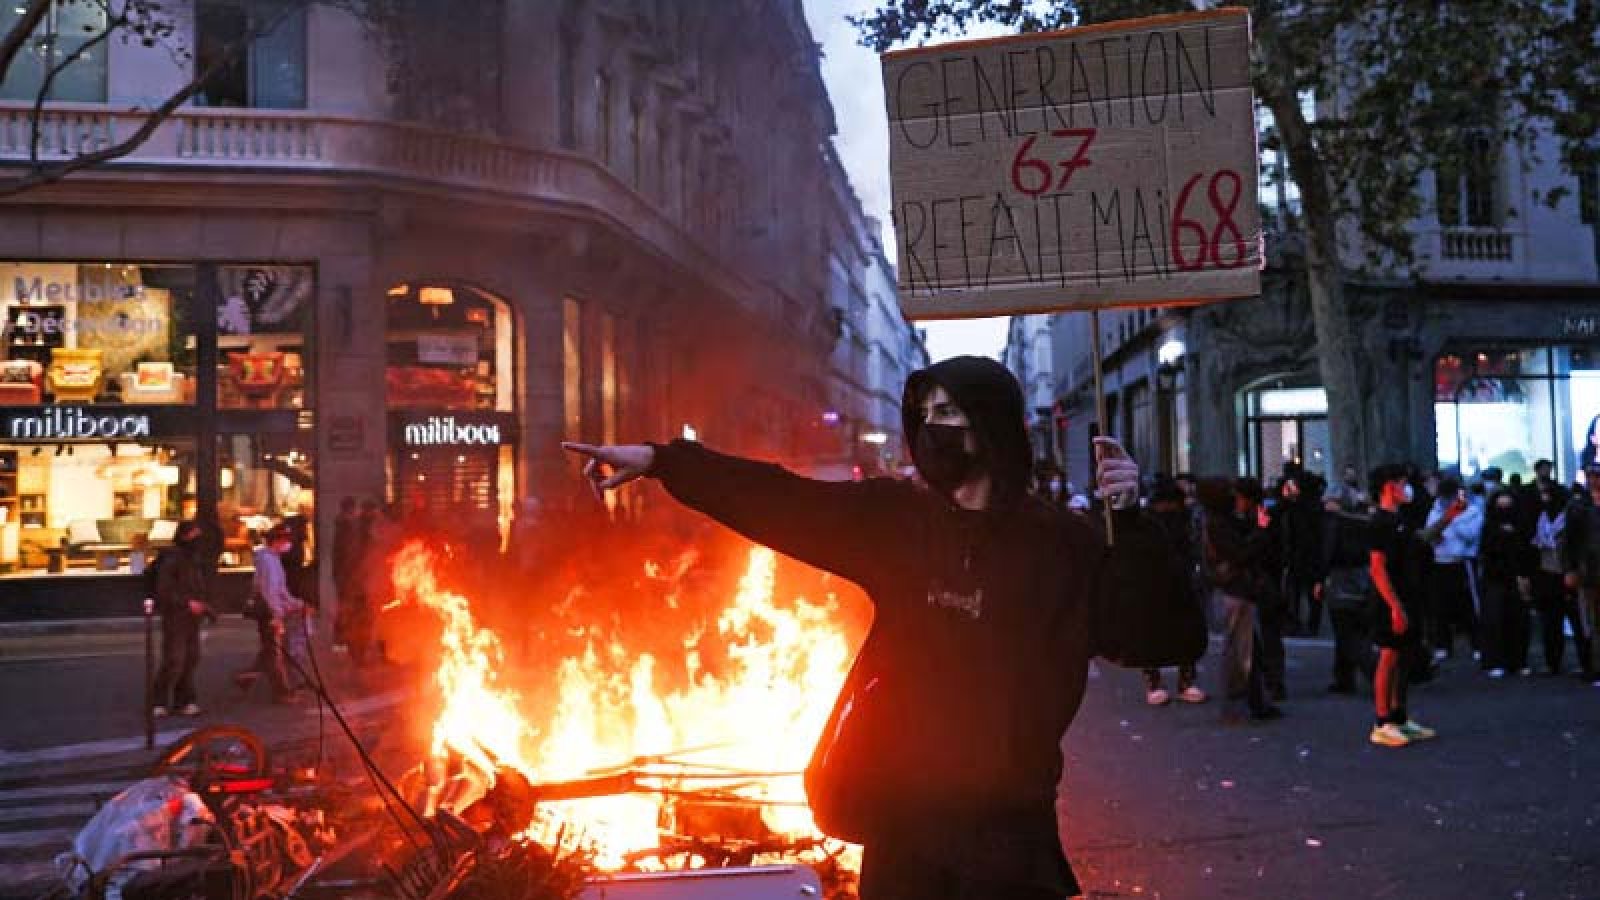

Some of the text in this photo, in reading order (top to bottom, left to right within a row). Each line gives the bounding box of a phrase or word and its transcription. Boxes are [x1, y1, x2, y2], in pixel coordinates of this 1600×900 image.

[1011, 128, 1097, 195] 67
[903, 192, 1074, 298] REFAIT
[1171, 169, 1246, 271] 68
